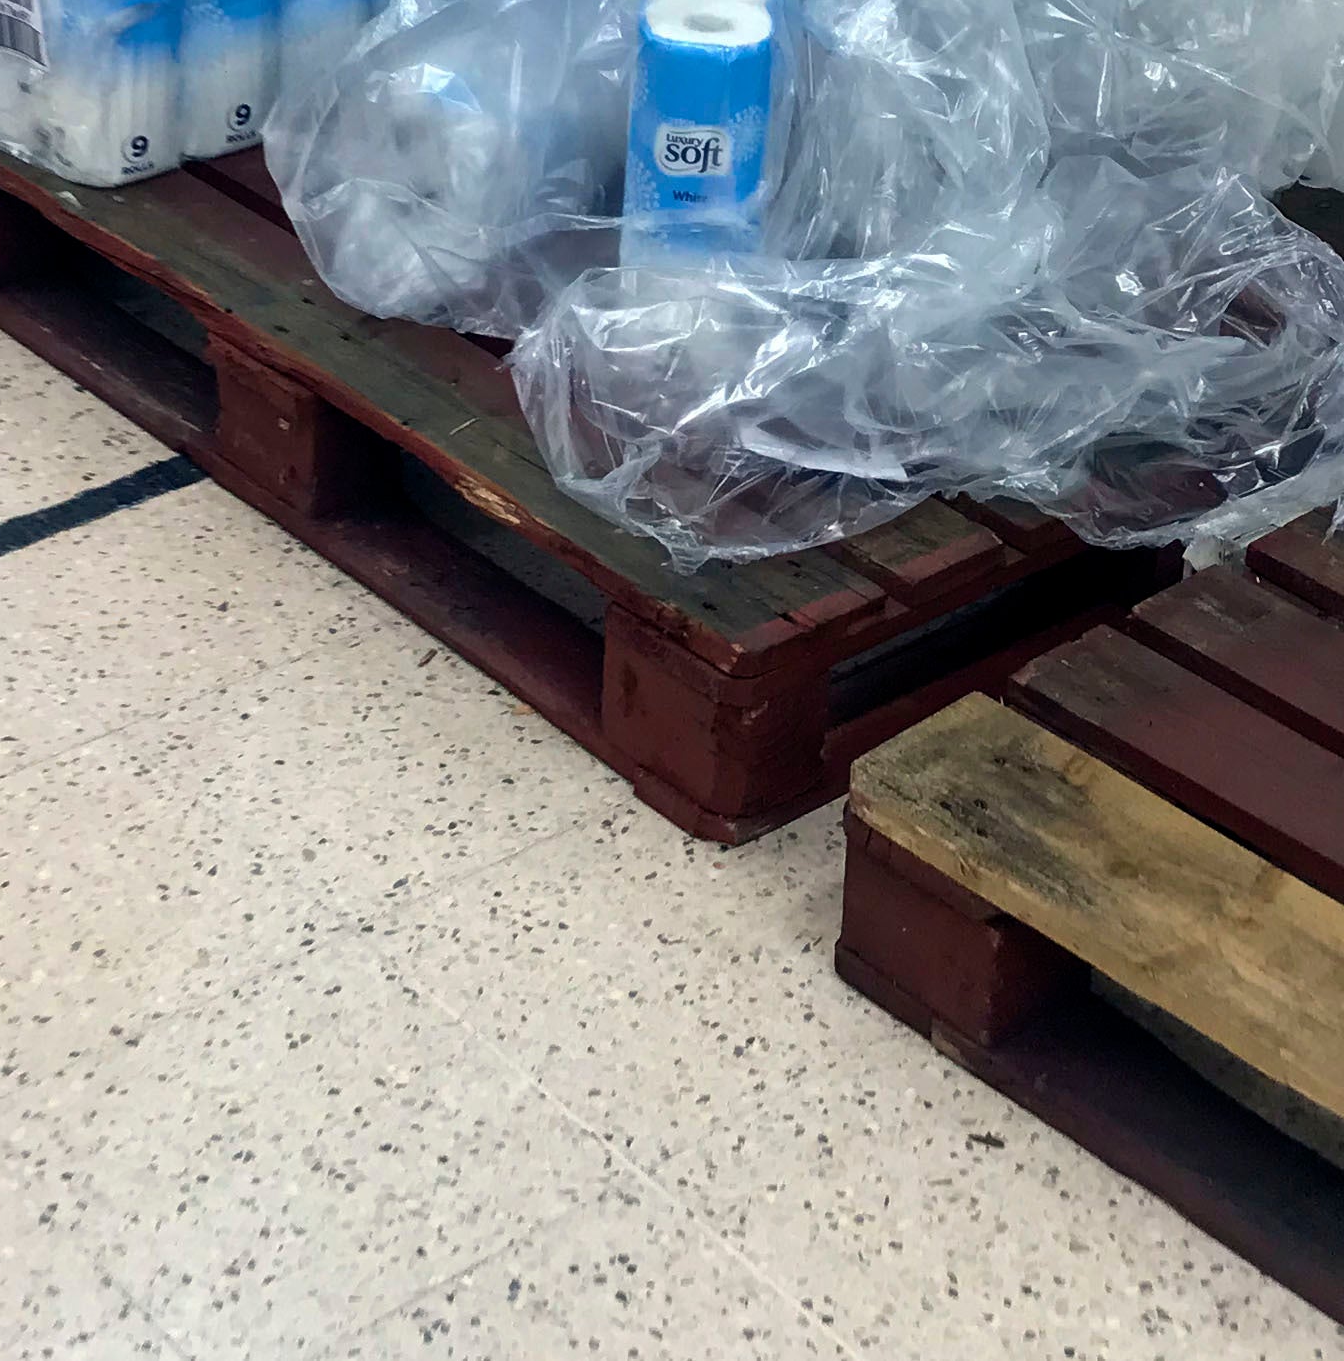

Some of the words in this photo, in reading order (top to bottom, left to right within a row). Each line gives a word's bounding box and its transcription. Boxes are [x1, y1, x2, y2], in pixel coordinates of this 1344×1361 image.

[235, 103, 251, 125] 9
[131, 135, 148, 157] 9
[666, 133, 702, 148] Luxury
[664, 137, 724, 173] soft
